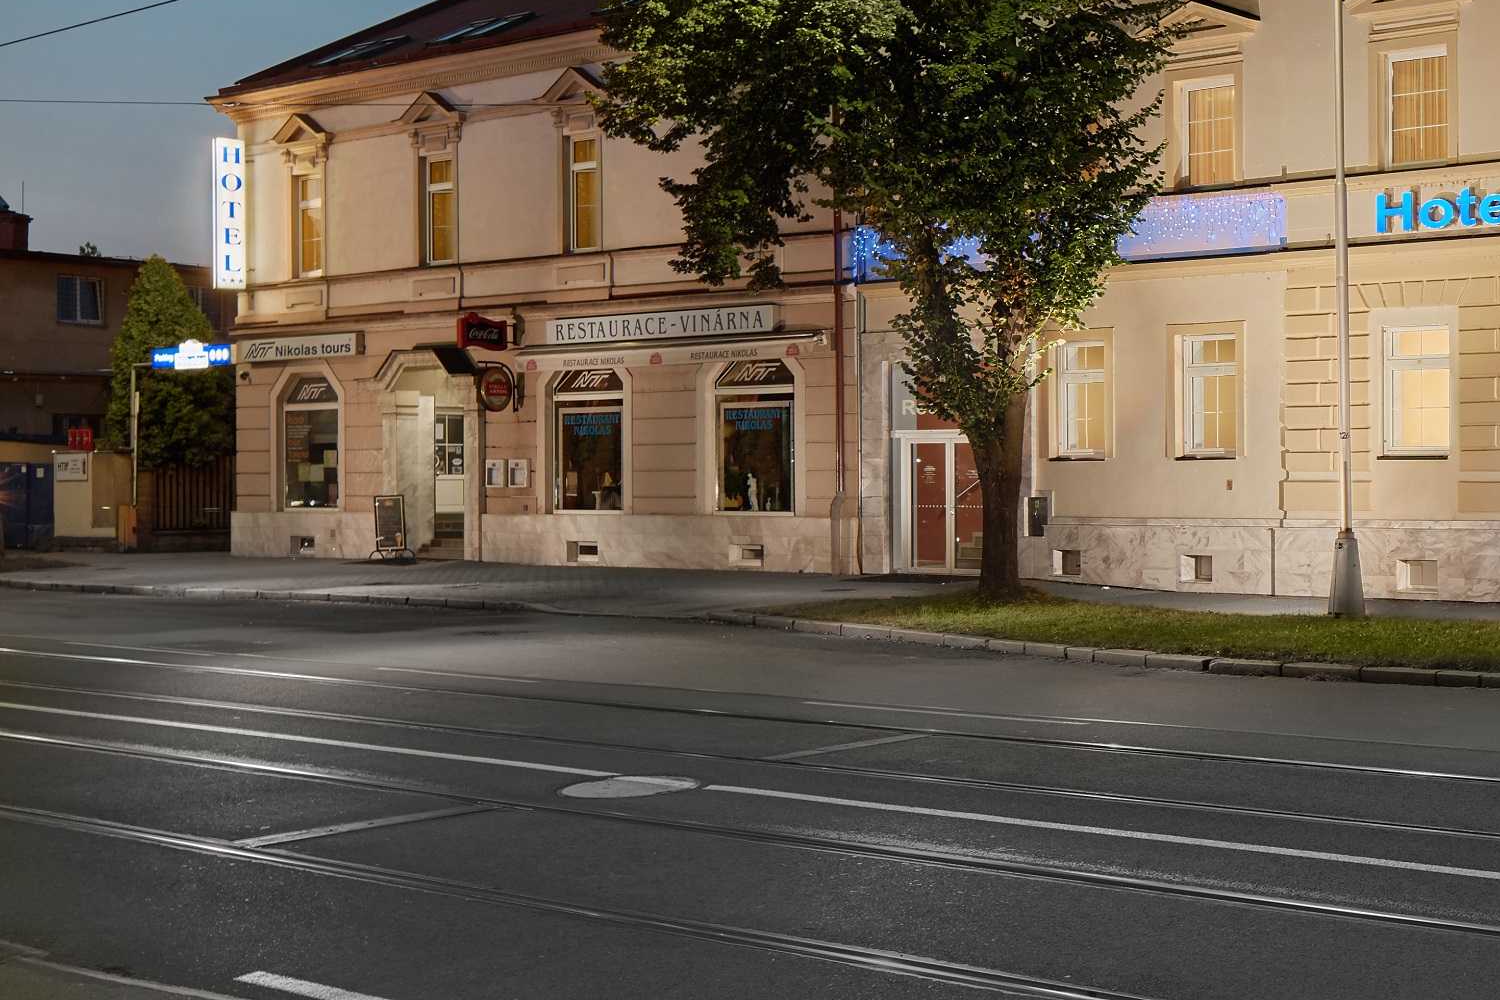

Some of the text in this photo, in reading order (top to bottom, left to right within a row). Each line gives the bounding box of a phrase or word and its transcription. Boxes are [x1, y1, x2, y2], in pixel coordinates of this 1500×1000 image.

[221, 145, 243, 273] HOTEL
[275, 343, 318, 357] Nikolas
[321, 341, 351, 355] tours
[690, 350, 730, 360] RESTAURACE
